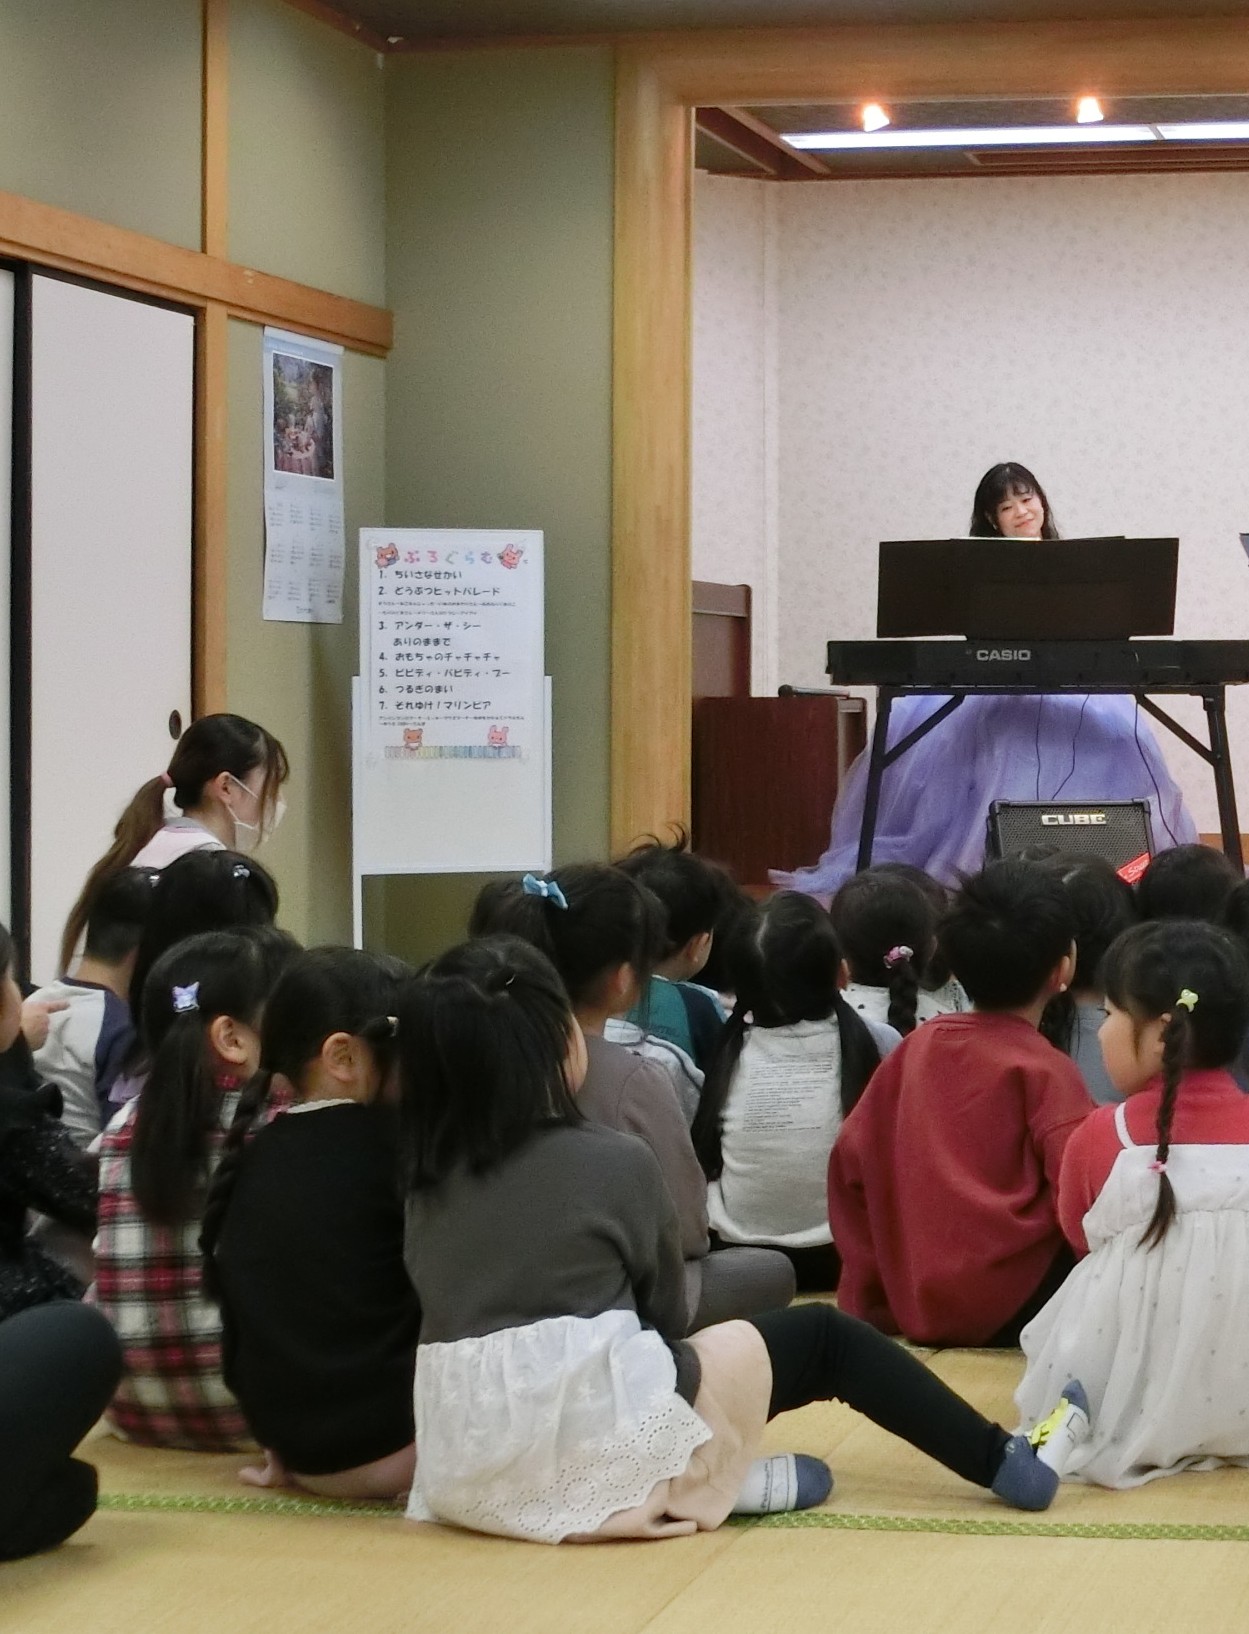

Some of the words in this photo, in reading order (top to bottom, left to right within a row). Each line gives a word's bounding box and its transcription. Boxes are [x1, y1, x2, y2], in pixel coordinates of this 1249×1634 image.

[395, 570, 462, 579] ちいさなせかい
[393, 638, 451, 646] ありのままで
[395, 652, 500, 661] おもちゃのチャチャチャ
[976, 649, 1031, 661] CASIO
[395, 685, 453, 694] つるぎのまい
[1041, 814, 1107, 826] CUBE
